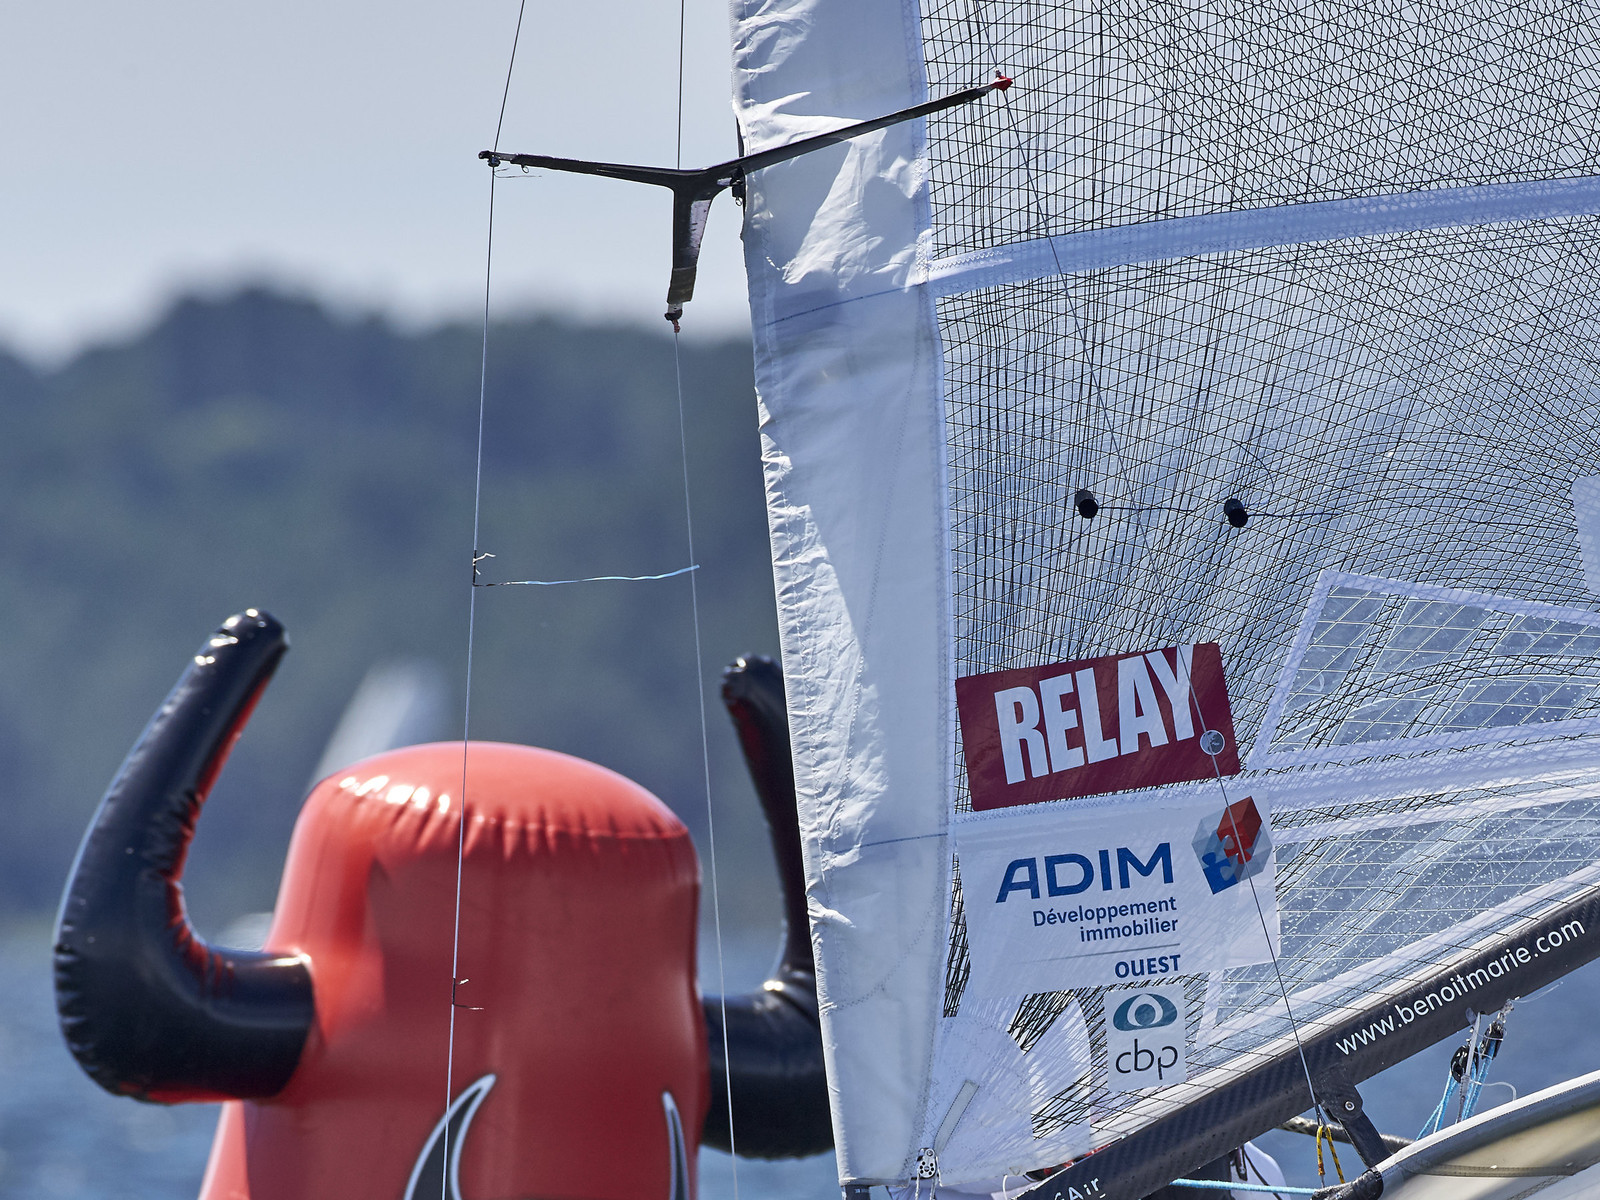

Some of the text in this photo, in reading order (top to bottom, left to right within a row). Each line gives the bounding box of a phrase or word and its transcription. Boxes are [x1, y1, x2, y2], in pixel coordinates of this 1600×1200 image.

[994, 644, 1201, 786] RELAY
[996, 842, 1174, 903] ADIM
[1033, 897, 1177, 927] Développement
[1080, 919, 1178, 942] immobilier
[1115, 954, 1181, 978] OUEST
[1335, 919, 1585, 1055] www.benoitmarie.com
[1115, 1039, 1178, 1080] cbp
